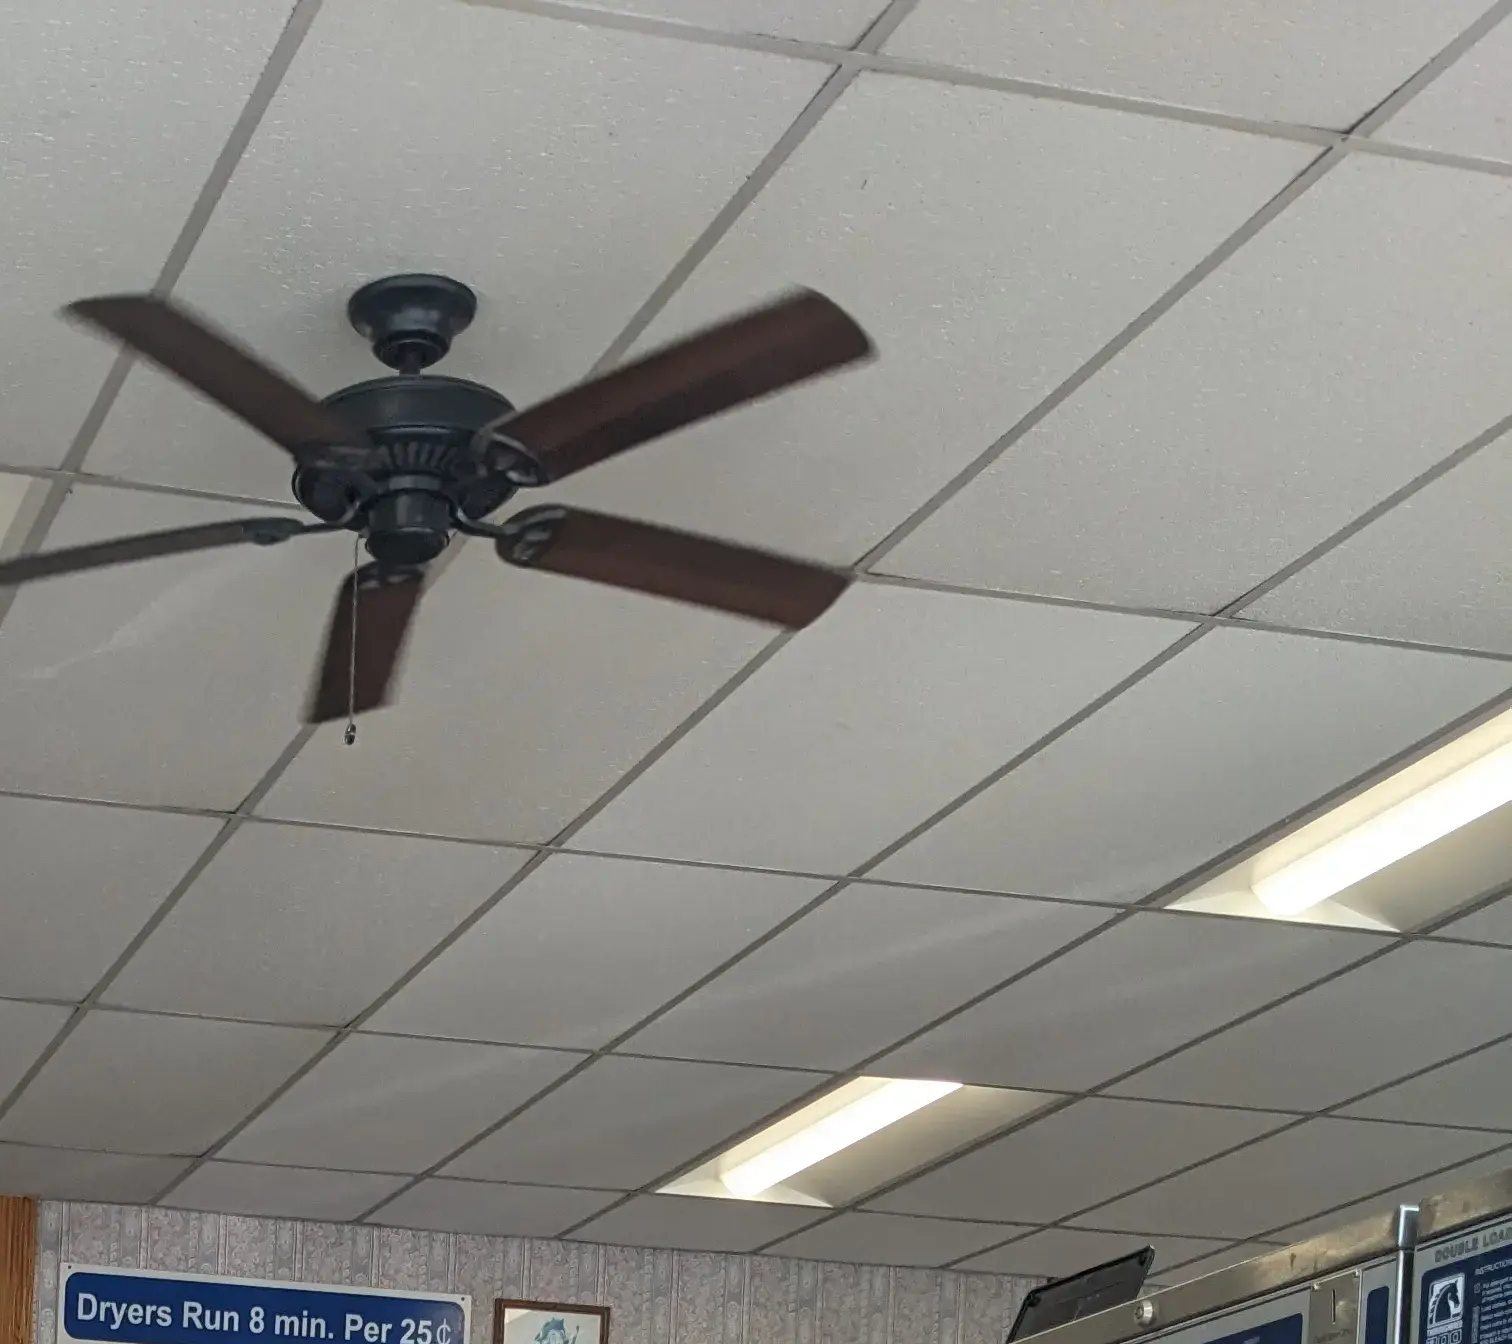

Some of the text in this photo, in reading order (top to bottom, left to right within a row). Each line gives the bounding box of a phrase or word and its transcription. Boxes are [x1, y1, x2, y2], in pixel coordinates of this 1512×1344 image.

[77, 1292, 172, 1331] Dryers
[182, 1300, 240, 1332] Run
[249, 1306, 265, 1334] 8
[274, 1310, 334, 1340] min.
[344, 1313, 392, 1344] Per
